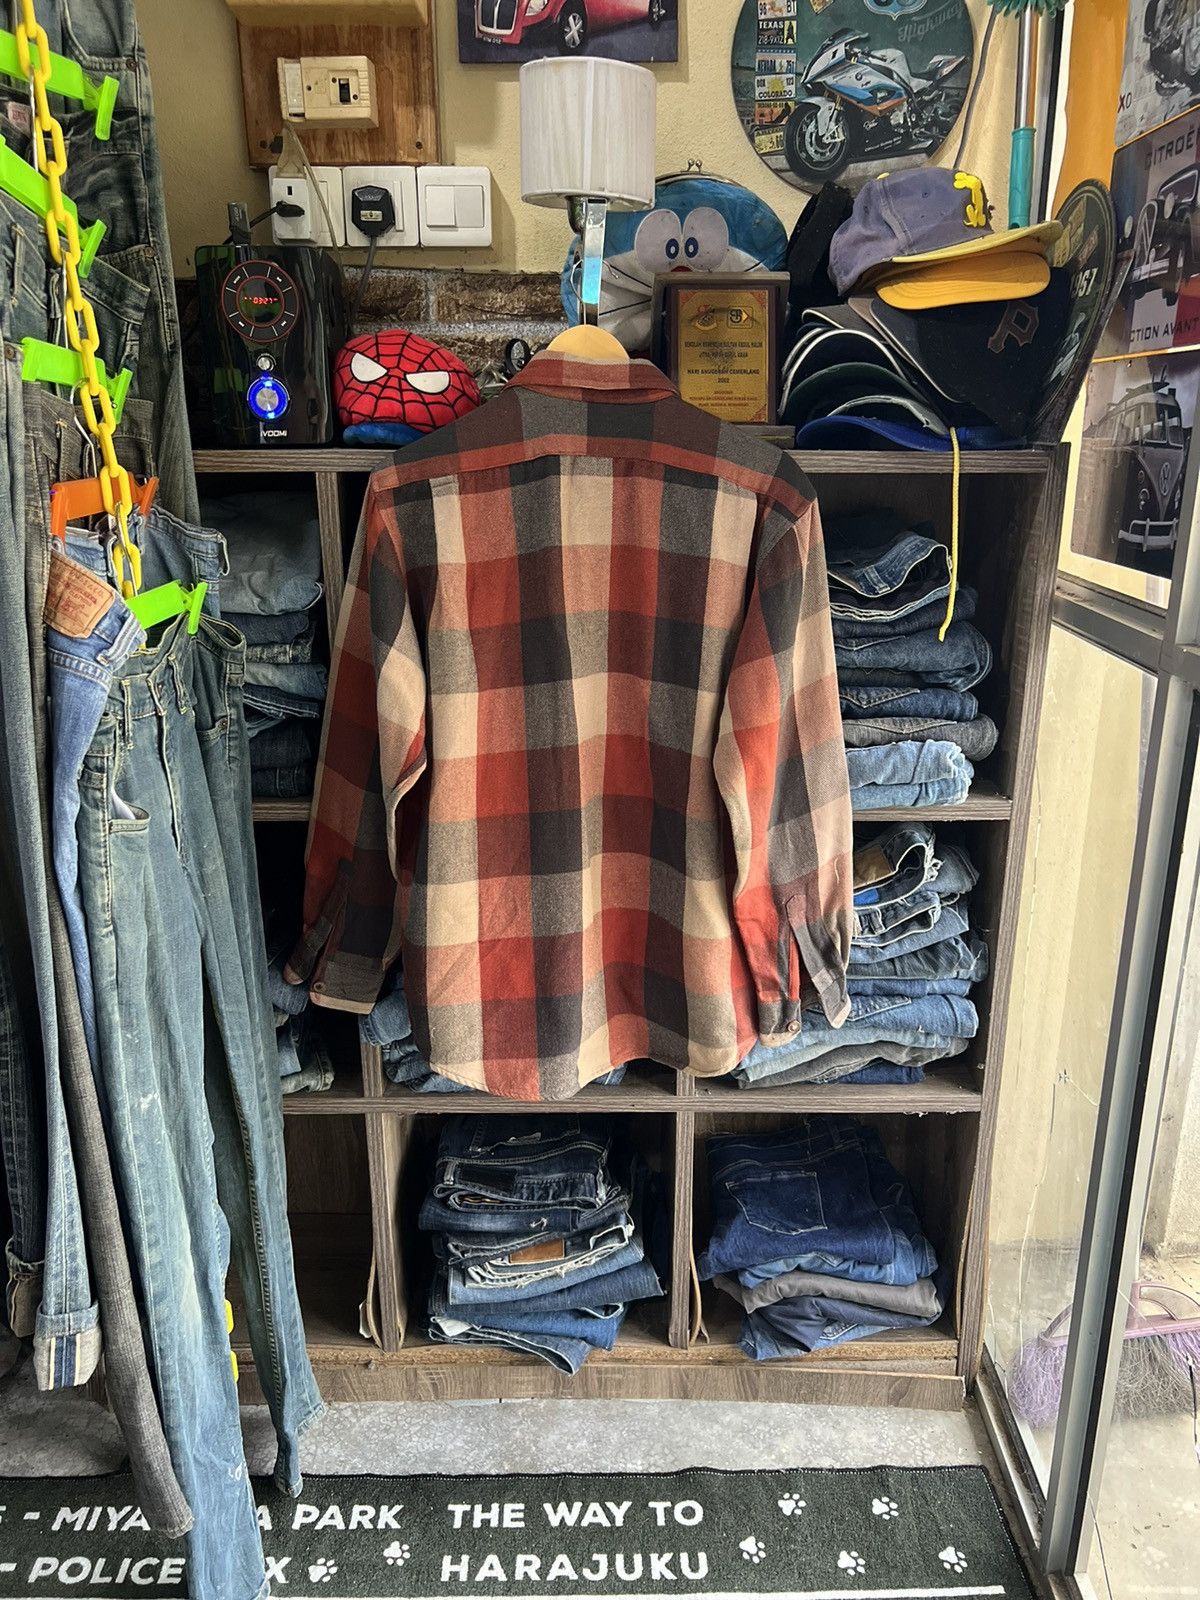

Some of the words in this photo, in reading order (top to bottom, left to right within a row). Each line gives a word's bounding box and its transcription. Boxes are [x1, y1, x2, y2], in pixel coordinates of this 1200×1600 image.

[759, 21, 784, 29] TEXAS
[758, 90, 793, 99] COLORADO
[1145, 124, 1200, 170] CITROË
[291, 1504, 405, 1531] PARK
[447, 1503, 526, 1529] THE
[543, 1501, 633, 1528] WAY
[648, 1500, 704, 1527] TO
[27, 1556, 187, 1585] POLICE
[440, 1552, 709, 1582] HARAJUKU
